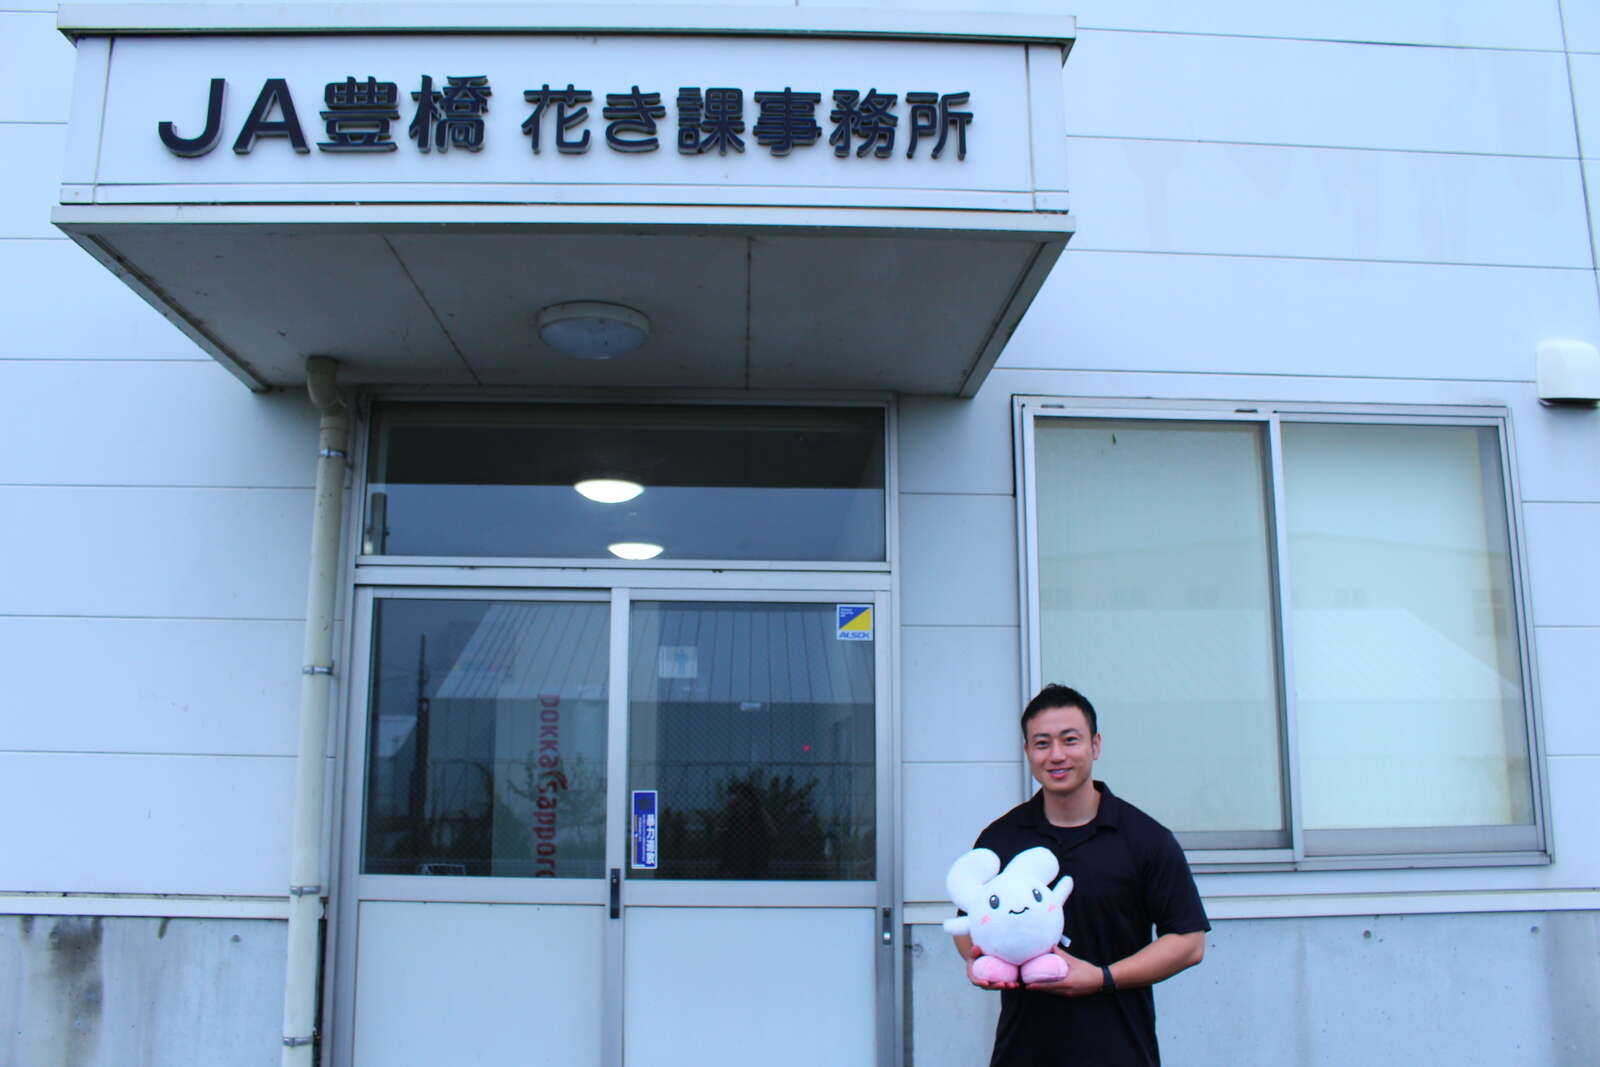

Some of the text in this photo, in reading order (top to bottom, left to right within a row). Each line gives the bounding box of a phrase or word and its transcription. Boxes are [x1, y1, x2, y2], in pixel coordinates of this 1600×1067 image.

[158, 75, 975, 160] JA豊橋 花き課事務所
